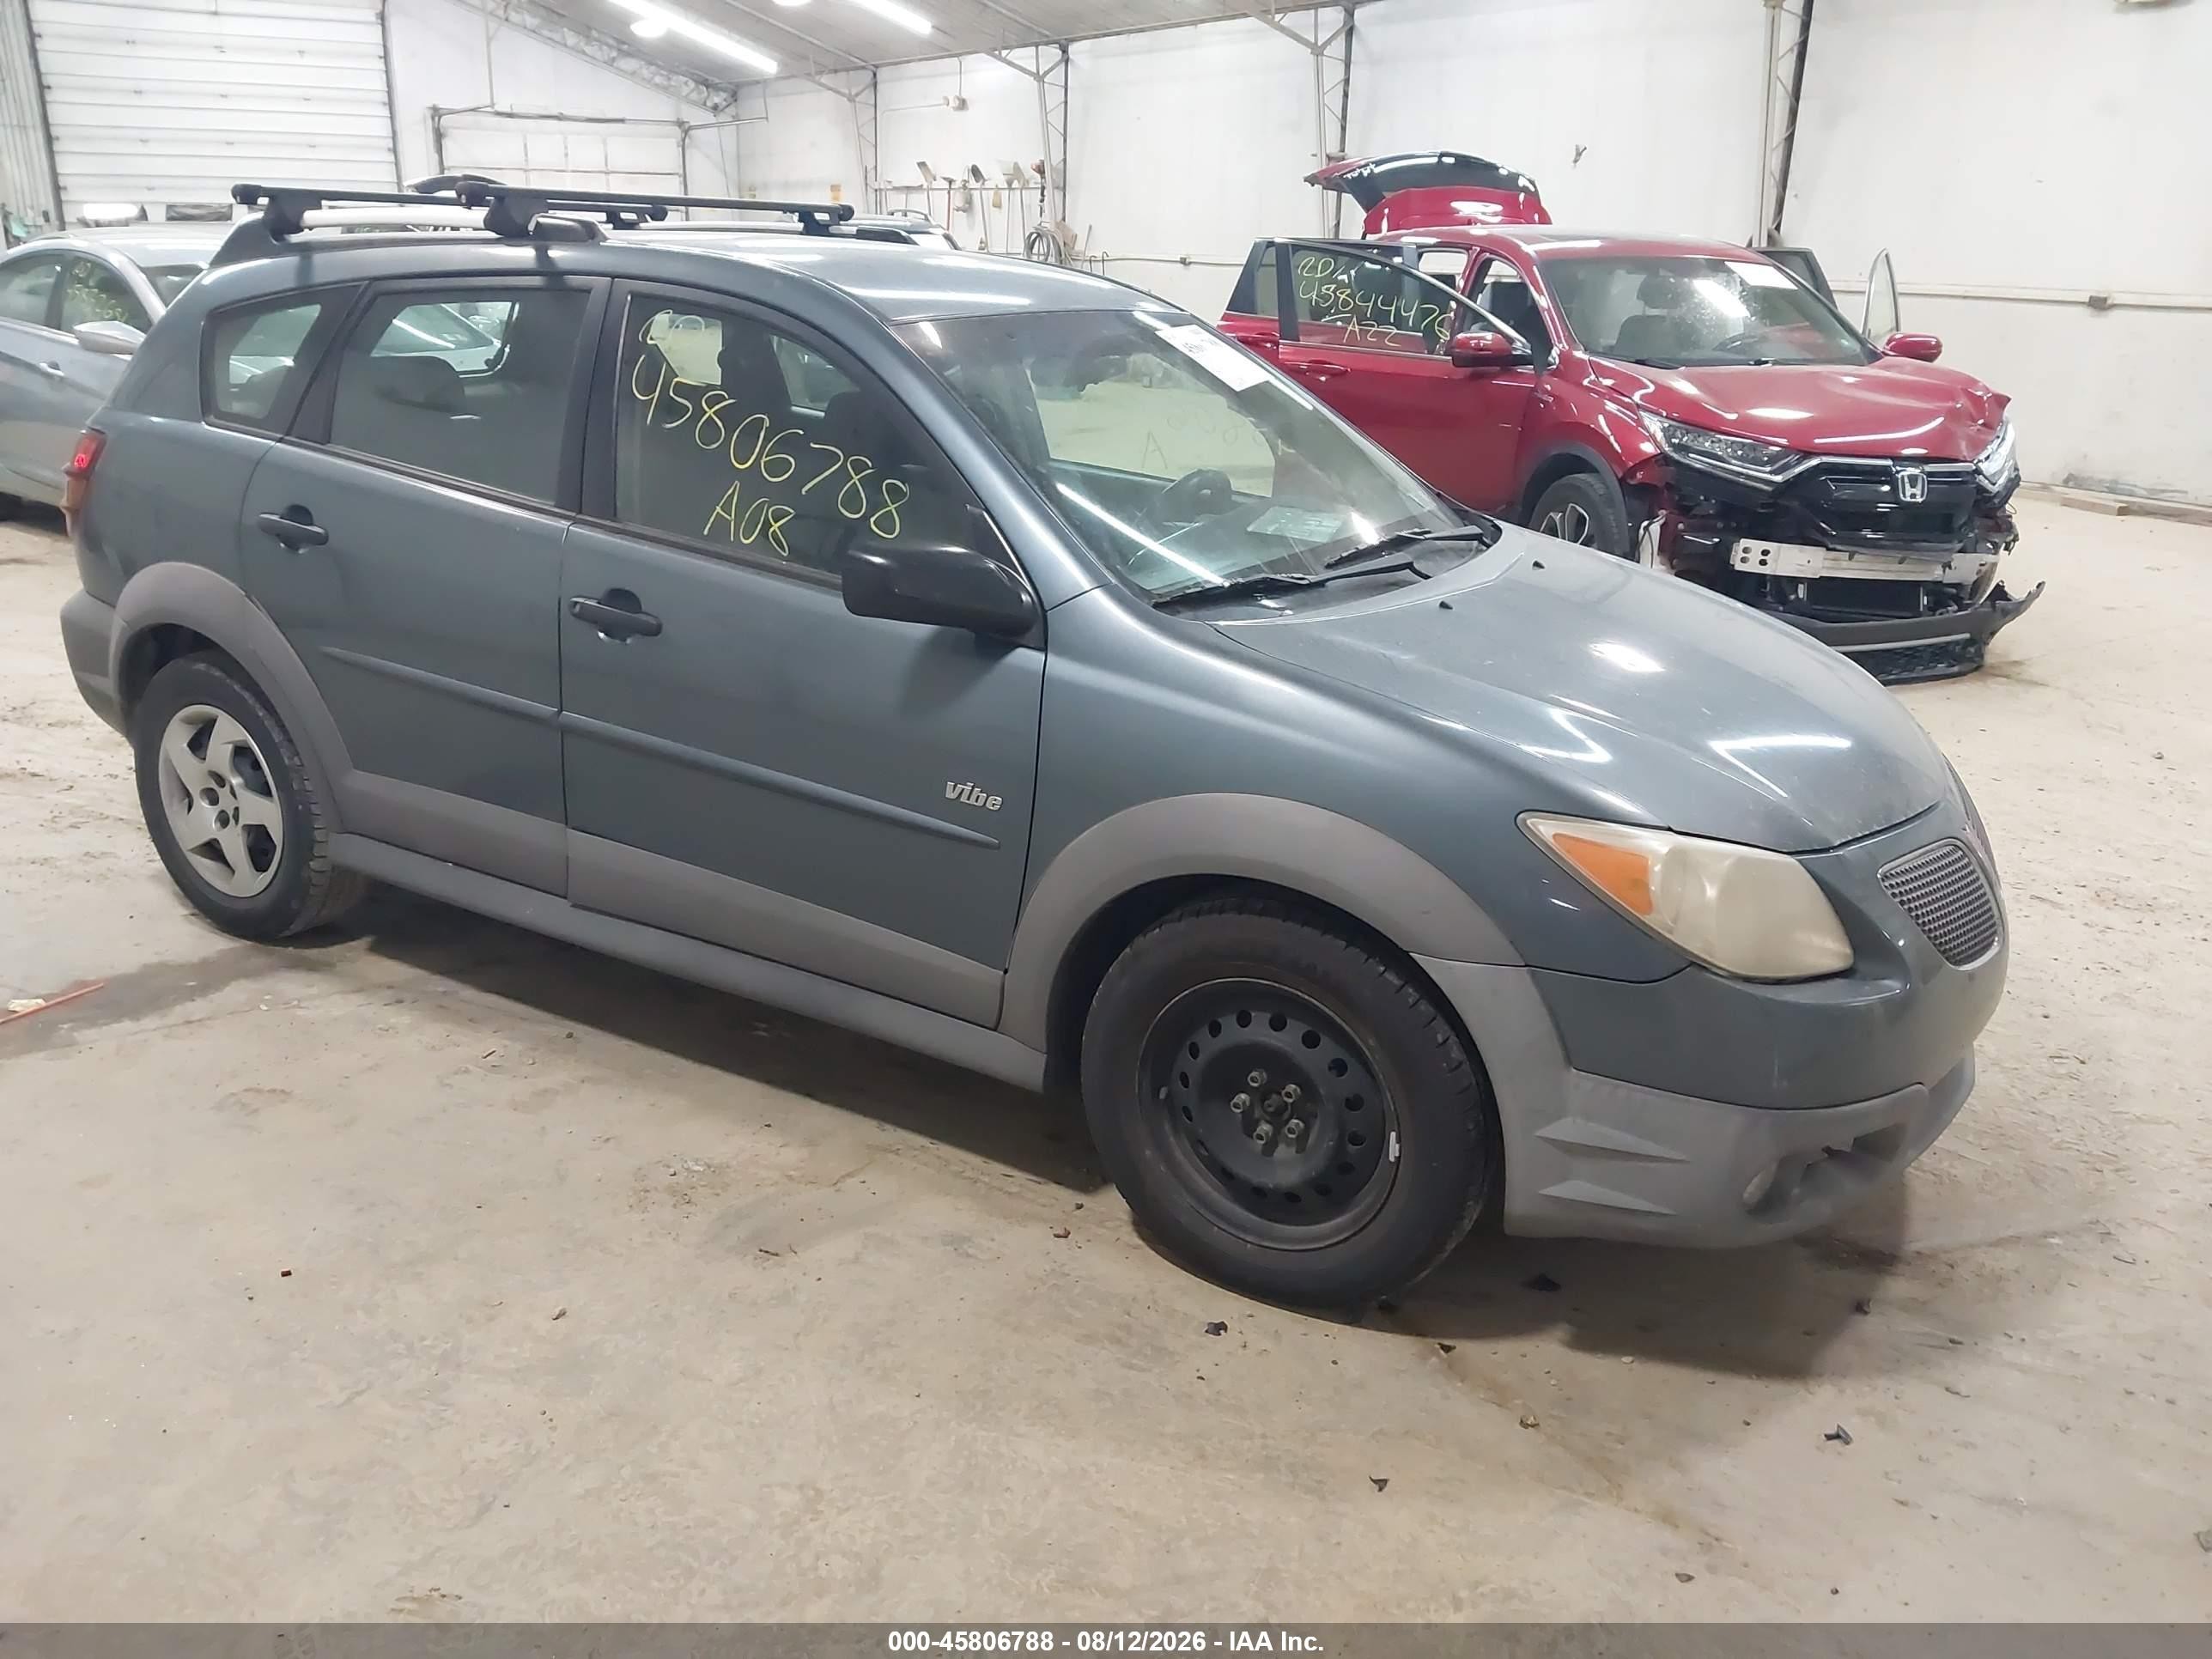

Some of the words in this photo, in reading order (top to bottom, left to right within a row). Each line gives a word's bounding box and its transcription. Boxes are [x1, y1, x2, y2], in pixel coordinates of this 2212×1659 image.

[632, 354, 910, 539] 45806788
[702, 481, 795, 556] A08
[945, 781, 1003, 811] Vibe
